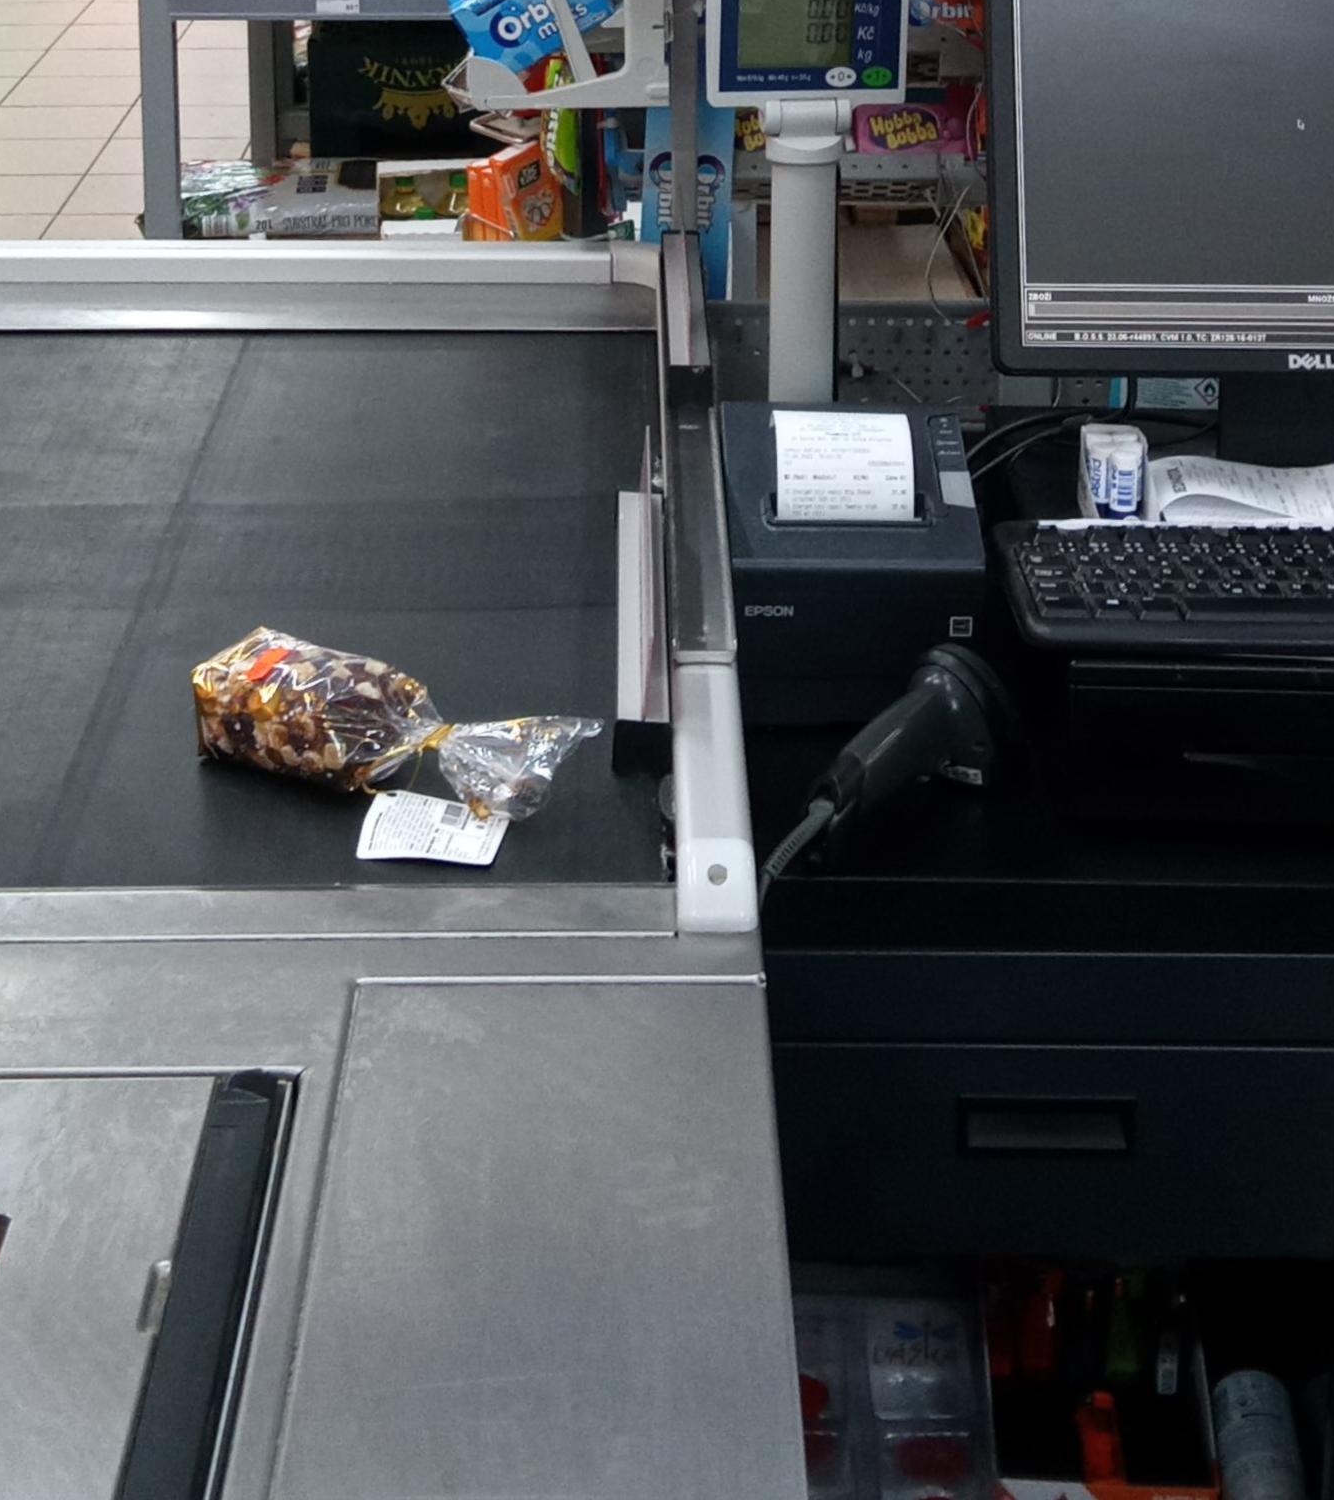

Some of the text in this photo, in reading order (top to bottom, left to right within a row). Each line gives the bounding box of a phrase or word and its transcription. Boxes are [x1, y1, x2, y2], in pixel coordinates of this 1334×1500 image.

[911, 0, 974, 21] Orbit
[857, 26, 875, 41] Kč
[857, 49, 873, 63] kg
[869, 108, 923, 137] Hubba
[886, 121, 939, 150] Bubba
[331, 213, 351, 229] PRO
[1027, 332, 1057, 341] ONLINE
[744, 605, 795, 618] EPSON
